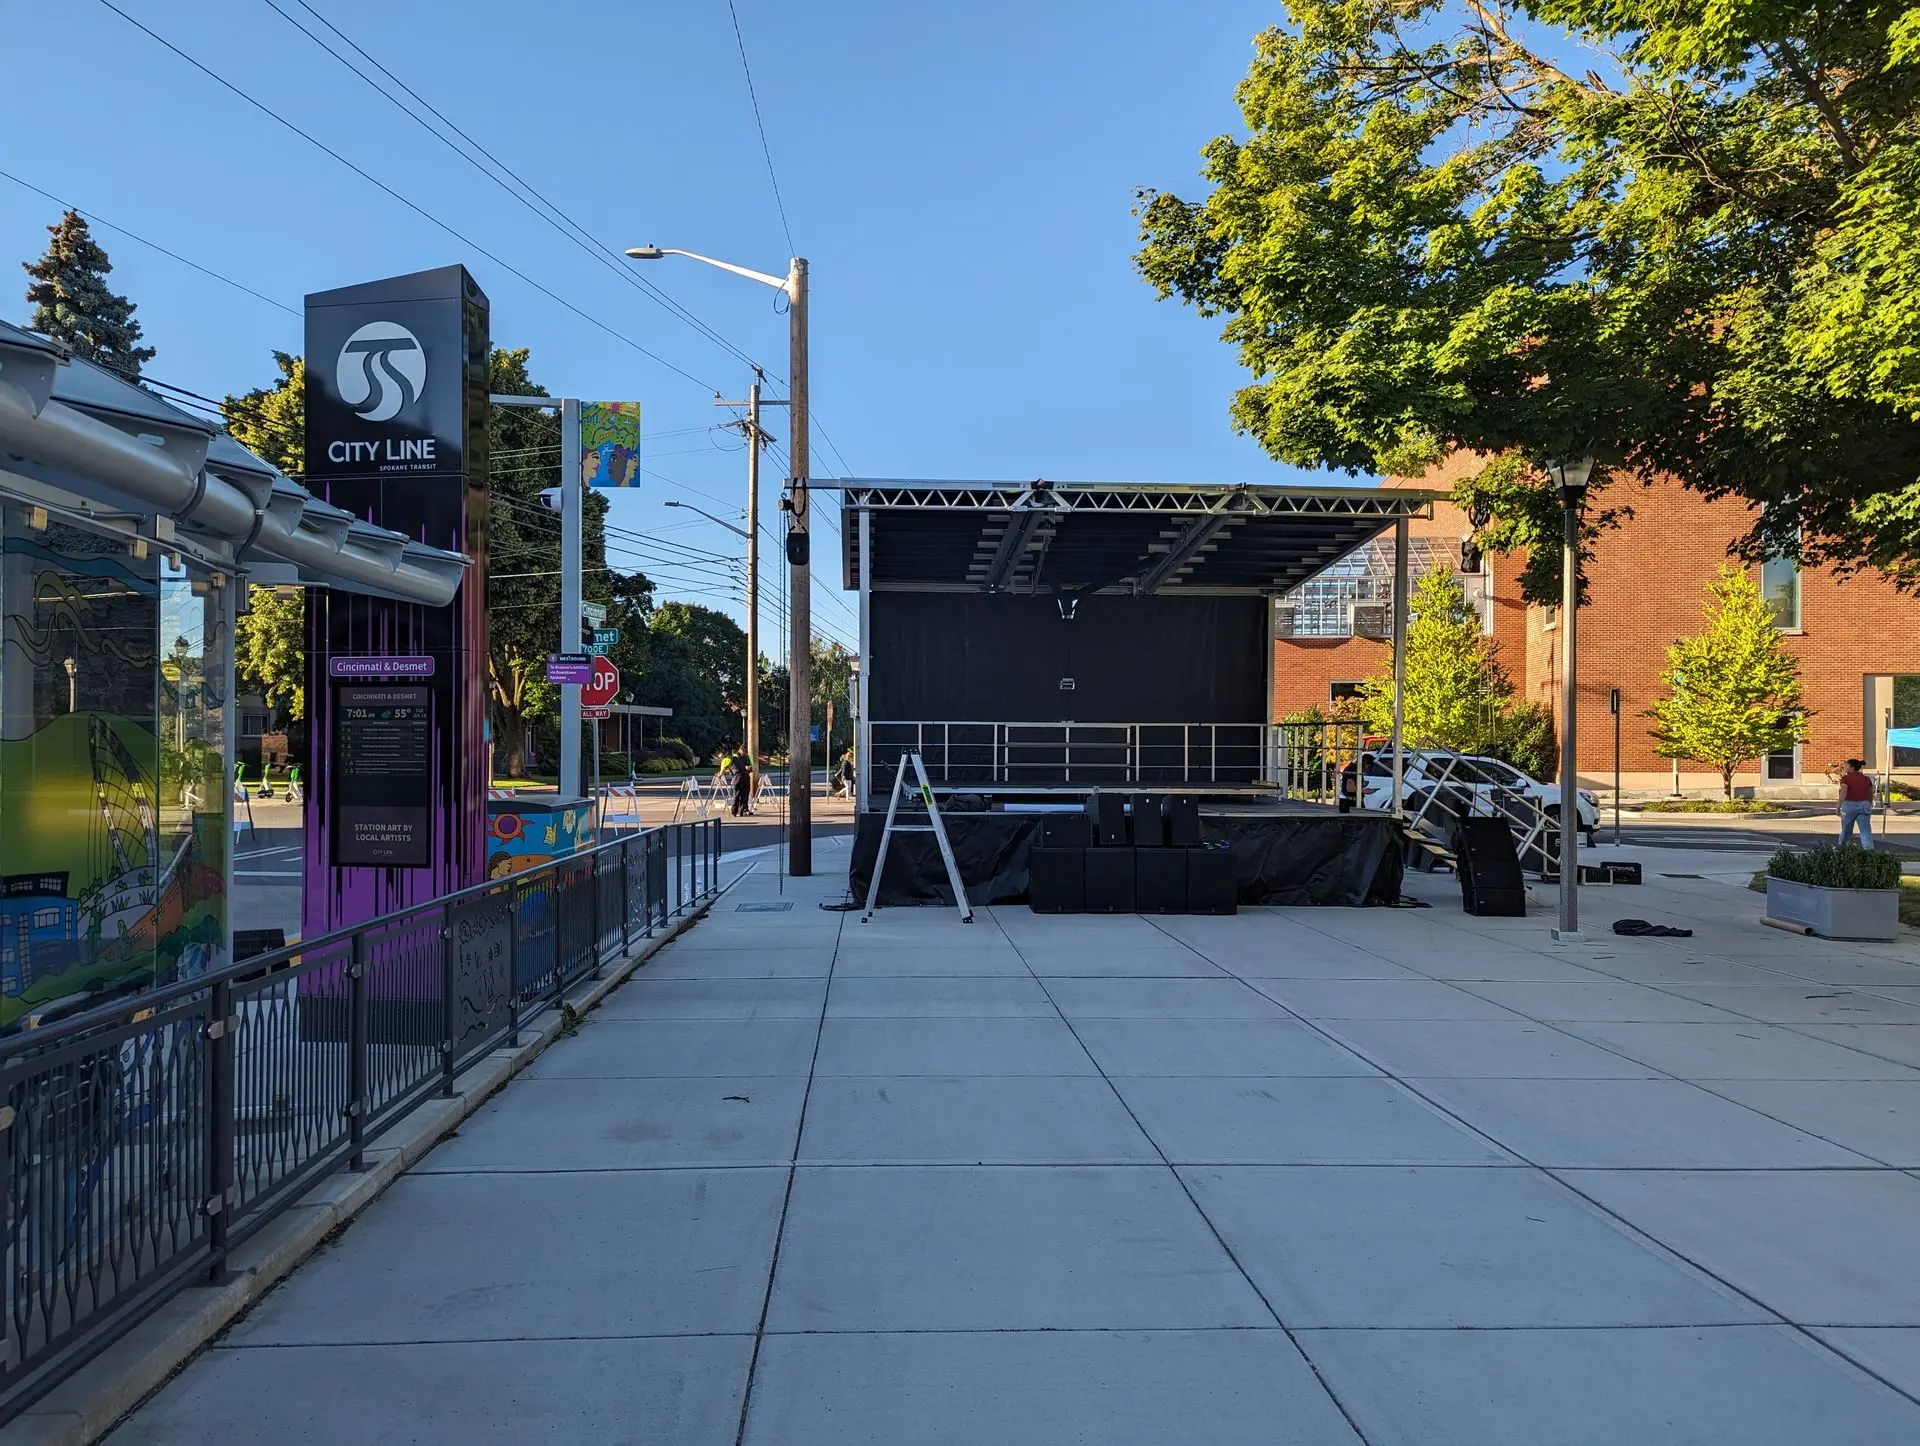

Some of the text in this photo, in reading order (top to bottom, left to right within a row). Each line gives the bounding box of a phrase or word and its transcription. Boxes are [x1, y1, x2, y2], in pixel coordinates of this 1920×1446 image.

[328, 438, 436, 463] CITY LINE
[379, 463, 437, 472] SPOKANE TRANSIT
[594, 630, 615, 642] met
[336, 661, 427, 672] Cincinnati & Desmet
[346, 708, 367, 718] 7:01
[354, 823, 413, 832] STATION ART BY
[355, 833, 412, 842] LOCAL ARTISTS
